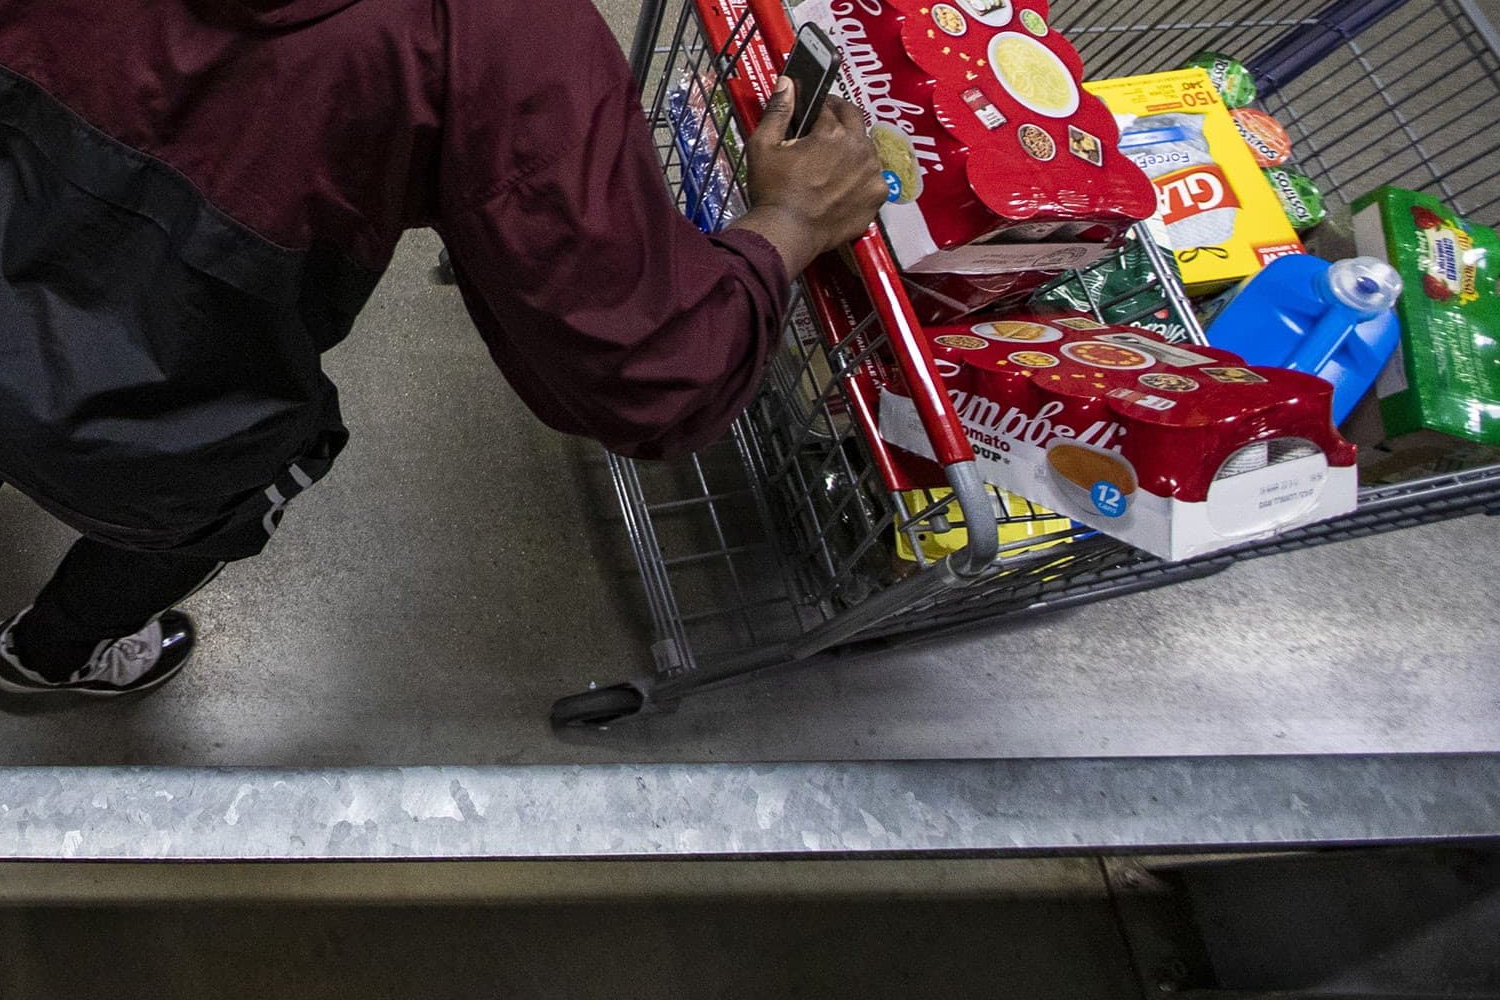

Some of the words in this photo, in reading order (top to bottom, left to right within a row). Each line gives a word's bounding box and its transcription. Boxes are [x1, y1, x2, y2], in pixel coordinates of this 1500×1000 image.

[835, 72, 851, 103] SOU
[836, 45, 855, 86] Chicken
[852, 88, 872, 128] Noodle
[1182, 91, 1217, 108] 150
[1153, 172, 1224, 217] GLA
[1443, 237, 1457, 281] CRUSHED
[934, 358, 1128, 454] ampbell's
[961, 424, 1011, 454] omato
[973, 443, 1002, 462] OUP
[1097, 483, 1122, 508] 12
